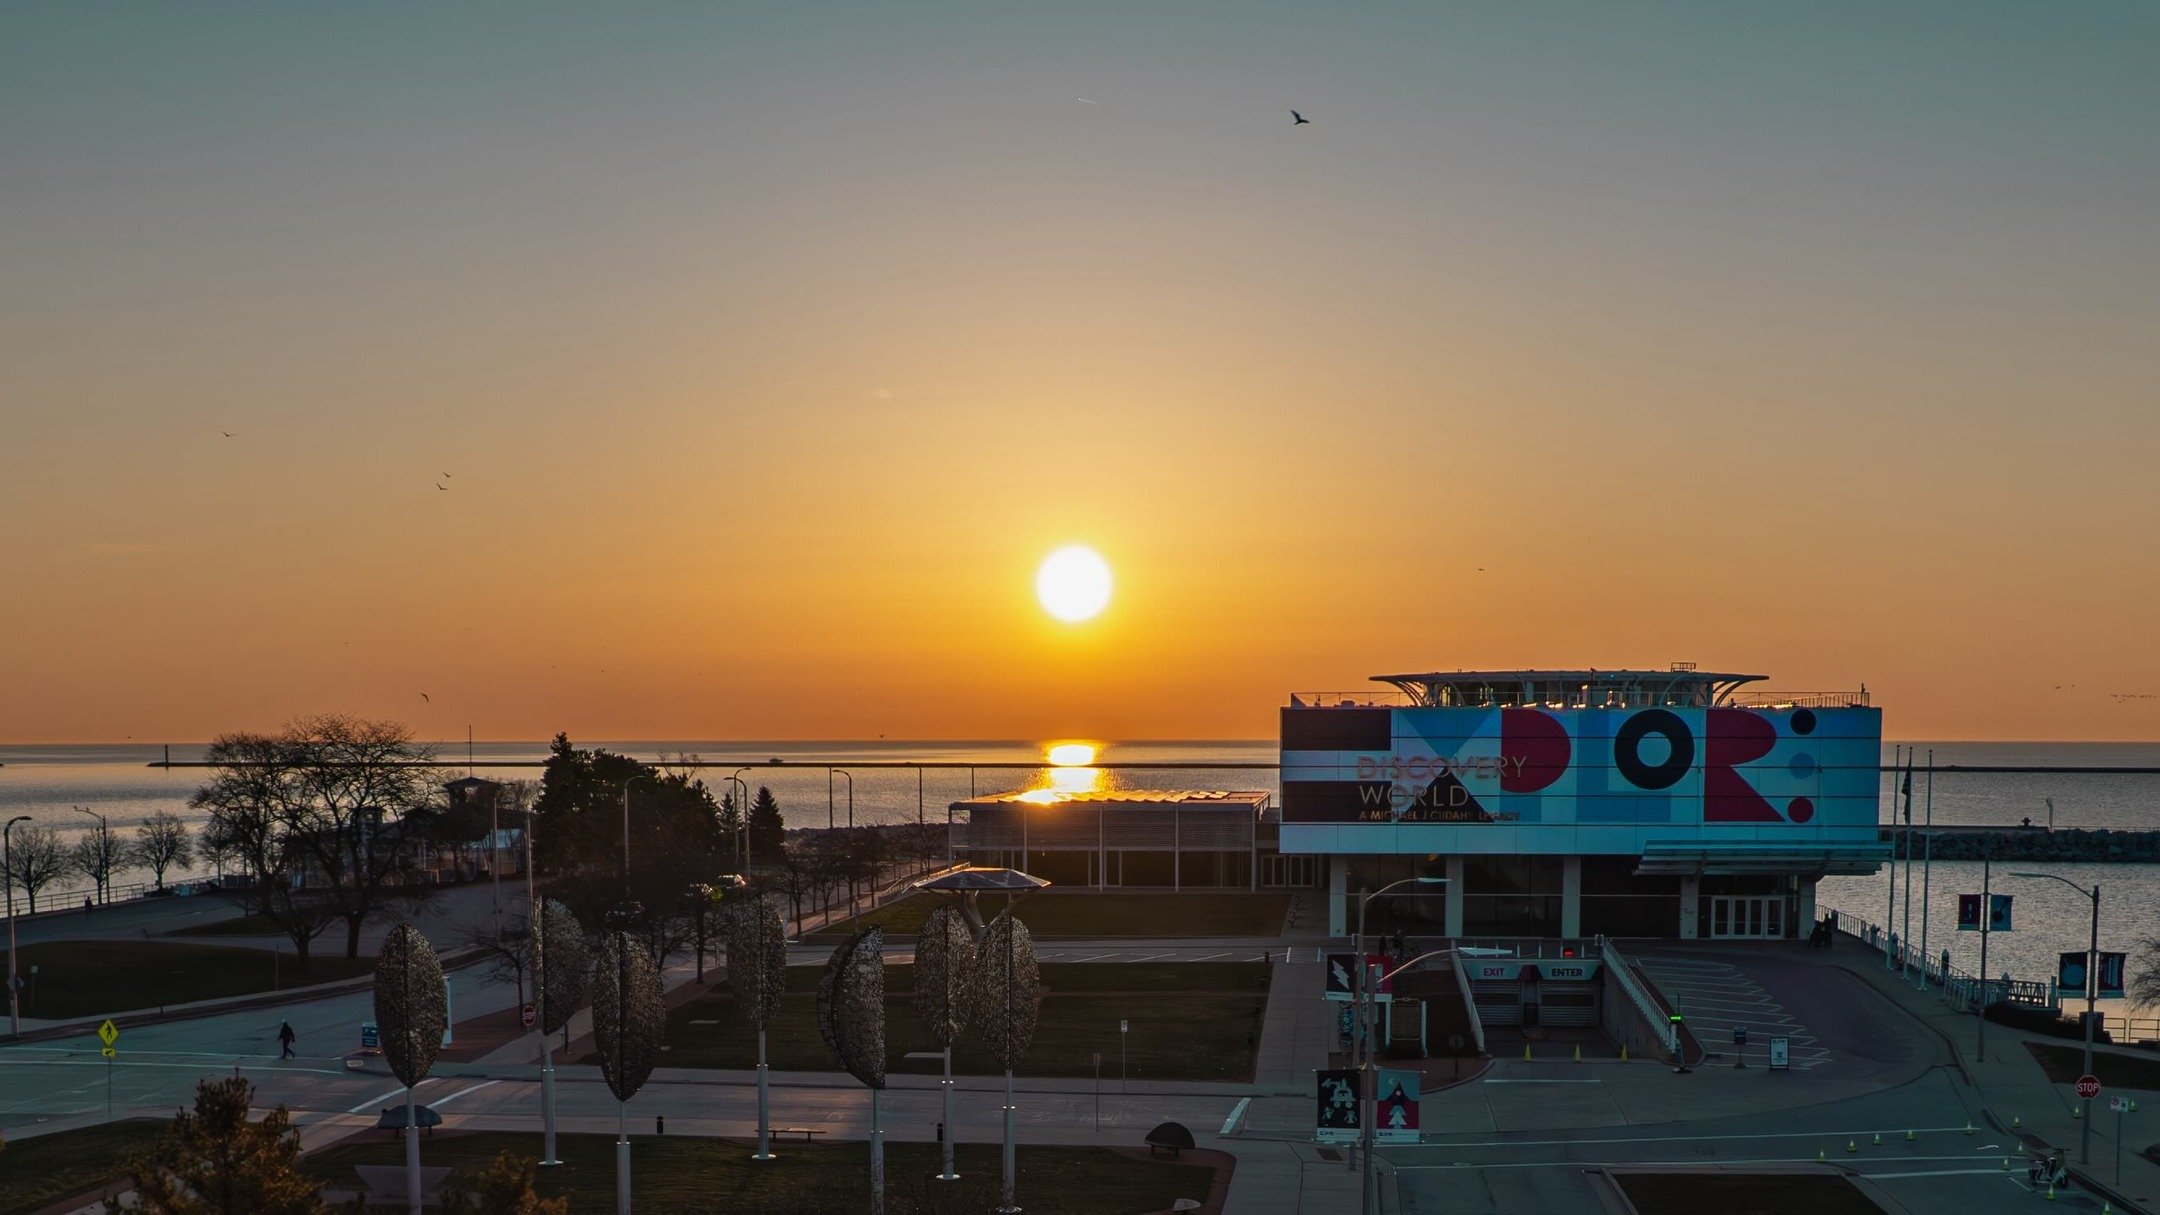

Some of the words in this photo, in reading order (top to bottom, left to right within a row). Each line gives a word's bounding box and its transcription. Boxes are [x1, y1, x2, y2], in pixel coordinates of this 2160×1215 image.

[1356, 755, 1527, 780] DISCOVERY
[1358, 784, 1469, 808] WORLD
[1358, 810, 1367, 821] A
[1483, 967, 1505, 977] EXIT
[1551, 968, 1583, 977] ENTER
[2077, 1083, 2099, 1093] STOP
